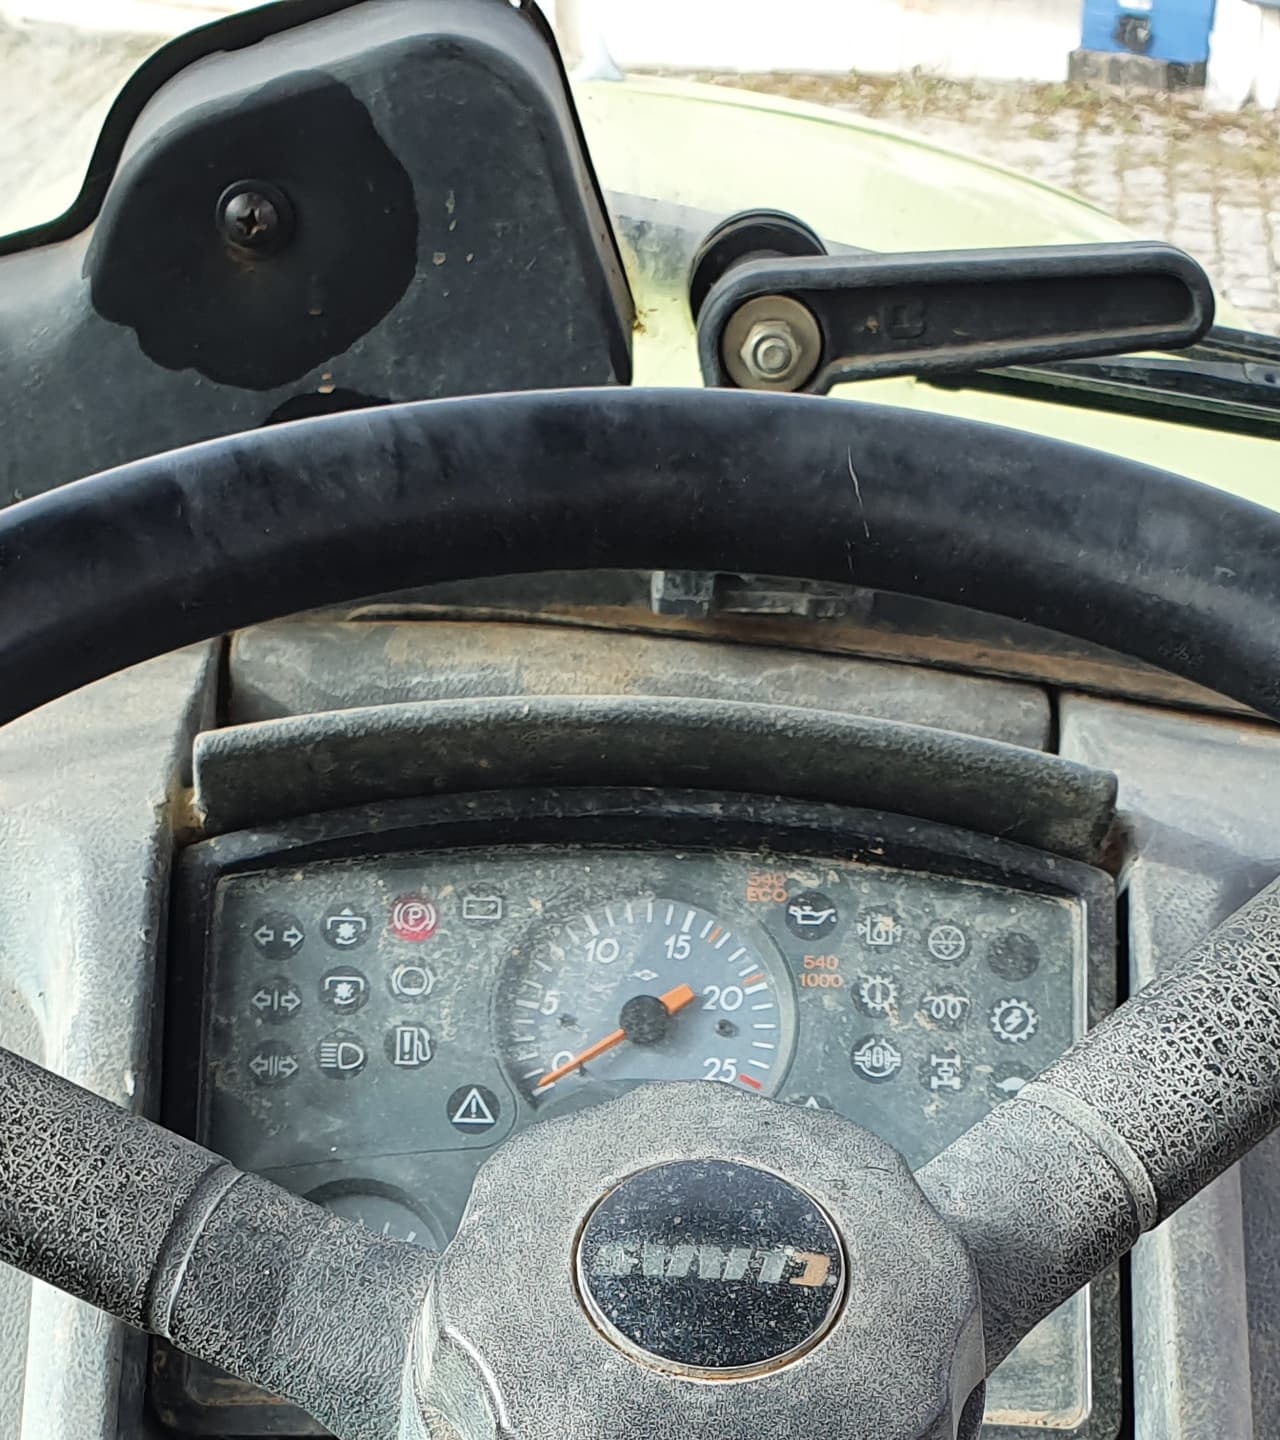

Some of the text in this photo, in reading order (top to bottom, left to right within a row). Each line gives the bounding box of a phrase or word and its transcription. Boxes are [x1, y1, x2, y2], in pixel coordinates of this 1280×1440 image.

[747, 887, 788, 903] ECO
[584, 937, 620, 963] 10
[664, 934, 692, 961] 15
[804, 955, 839, 970] 540
[799, 972, 844, 988] 1000
[541, 993, 559, 1016] 5
[702, 985, 744, 1011] 20
[702, 1057, 737, 1082] 25
